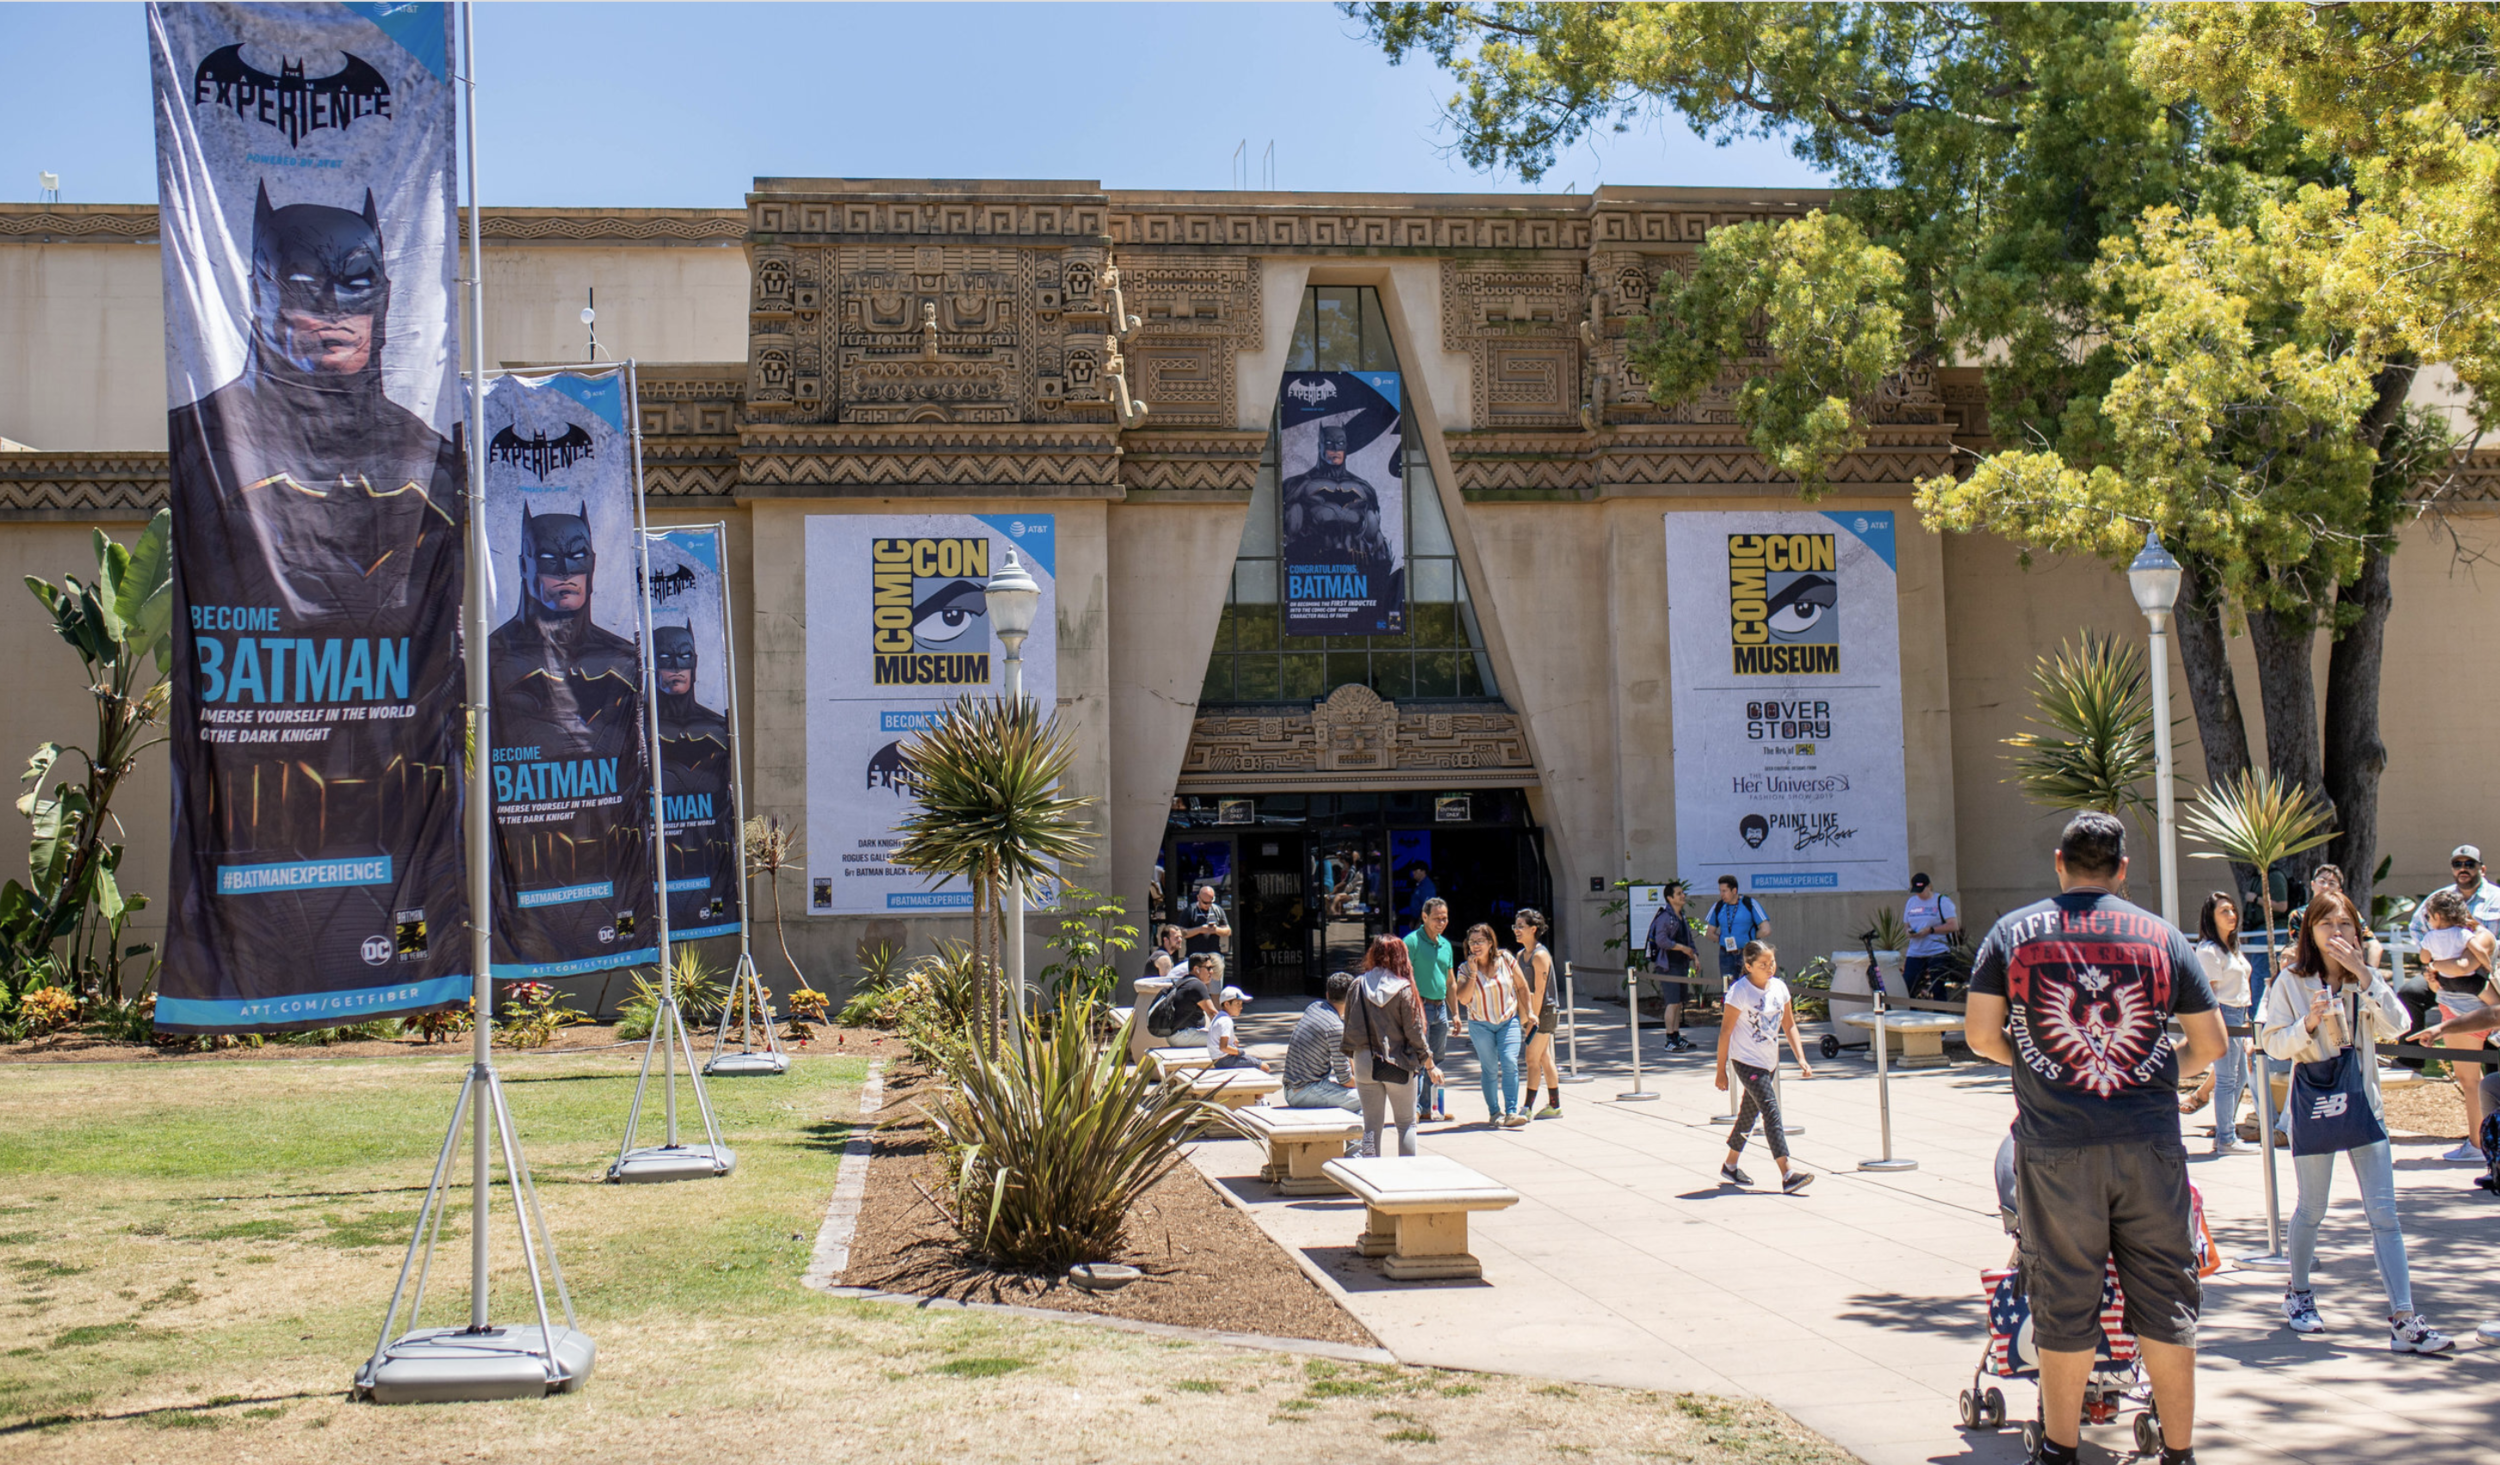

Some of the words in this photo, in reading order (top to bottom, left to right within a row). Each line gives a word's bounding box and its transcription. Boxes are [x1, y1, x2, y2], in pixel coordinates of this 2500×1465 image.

[195, 79, 392, 150] EXPERIENCE
[246, 153, 297, 167] POWERED
[300, 155, 314, 167] BY
[316, 157, 343, 169] AT&T
[490, 444, 595, 483] EXPERIENCE
[1028, 525, 1048, 534] AT&T
[1870, 521, 1888, 530] AT&T
[912, 538, 988, 577] CON
[1765, 534, 1836, 572] CON
[1289, 564, 1359, 575] CONGRATULATIONS,
[1289, 574, 1368, 599] BATMAN
[1729, 534, 1769, 644] COMIC
[874, 539, 913, 653] COMIC
[1348, 599, 1378, 607] INDUCTEE
[191, 605, 280, 631] BECOME
[1733, 645, 1839, 674] MUSEUM
[196, 636, 410, 703] BATMAN
[875, 654, 989, 685] MUSEUM
[200, 707, 254, 723] IMERSE
[256, 707, 324, 723] YOURSELF
[325, 708, 340, 722] IN
[342, 706, 367, 720] THE
[368, 704, 416, 719] WORLD
[1746, 701, 1830, 720] COVER
[885, 713, 932, 729] BECOME
[209, 728, 236, 743] THE
[238, 728, 279, 743] DARK
[280, 727, 331, 742] KNIGHT
[1747, 720, 1831, 740] STORY
[492, 746, 541, 762] BECOME
[1763, 746, 1774, 755] The
[494, 757, 618, 802] BATMAN
[1732, 776, 1763, 793] Her
[1766, 776, 1836, 793] Universe
[531, 801, 570, 811] YOURSELF
[571, 800, 580, 809] IN
[581, 799, 596, 808] THE
[598, 796, 623, 806] WORLD
[1749, 793, 1785, 801] FASHION
[1787, 793, 1812, 801] SHOW
[507, 814, 522, 825] THE
[523, 813, 544, 824] DARK
[546, 811, 576, 822] KNIGHT
[1769, 813, 1807, 829] PAINT
[1811, 813, 1838, 829] LIKE
[858, 838, 877, 848] DARK
[842, 853, 869, 863] ROGUES
[222, 861, 385, 890] #BATMANEXPERIENCE
[856, 867, 883, 877] BATMAN
[885, 866, 906, 876] BLACK
[1754, 874, 1834, 887] #BATMANEXPERIENCE
[519, 885, 610, 906] #BATMANEXPERIENCE
[890, 893, 974, 906] #BATMANEXPERIENC
[396, 908, 425, 925] BATMAN
[600, 929, 615, 941] DC
[2011, 910, 2171, 948] AFFLICTION
[363, 941, 391, 961] DC
[409, 950, 428, 960] YEARS
[1270, 949, 1303, 965] YEARS
[531, 954, 633, 975] ATT.COM/GETFIBER
[239, 987, 420, 1017] ATT.COM/GETFIBER
[2310, 1092, 2348, 1119] NB
